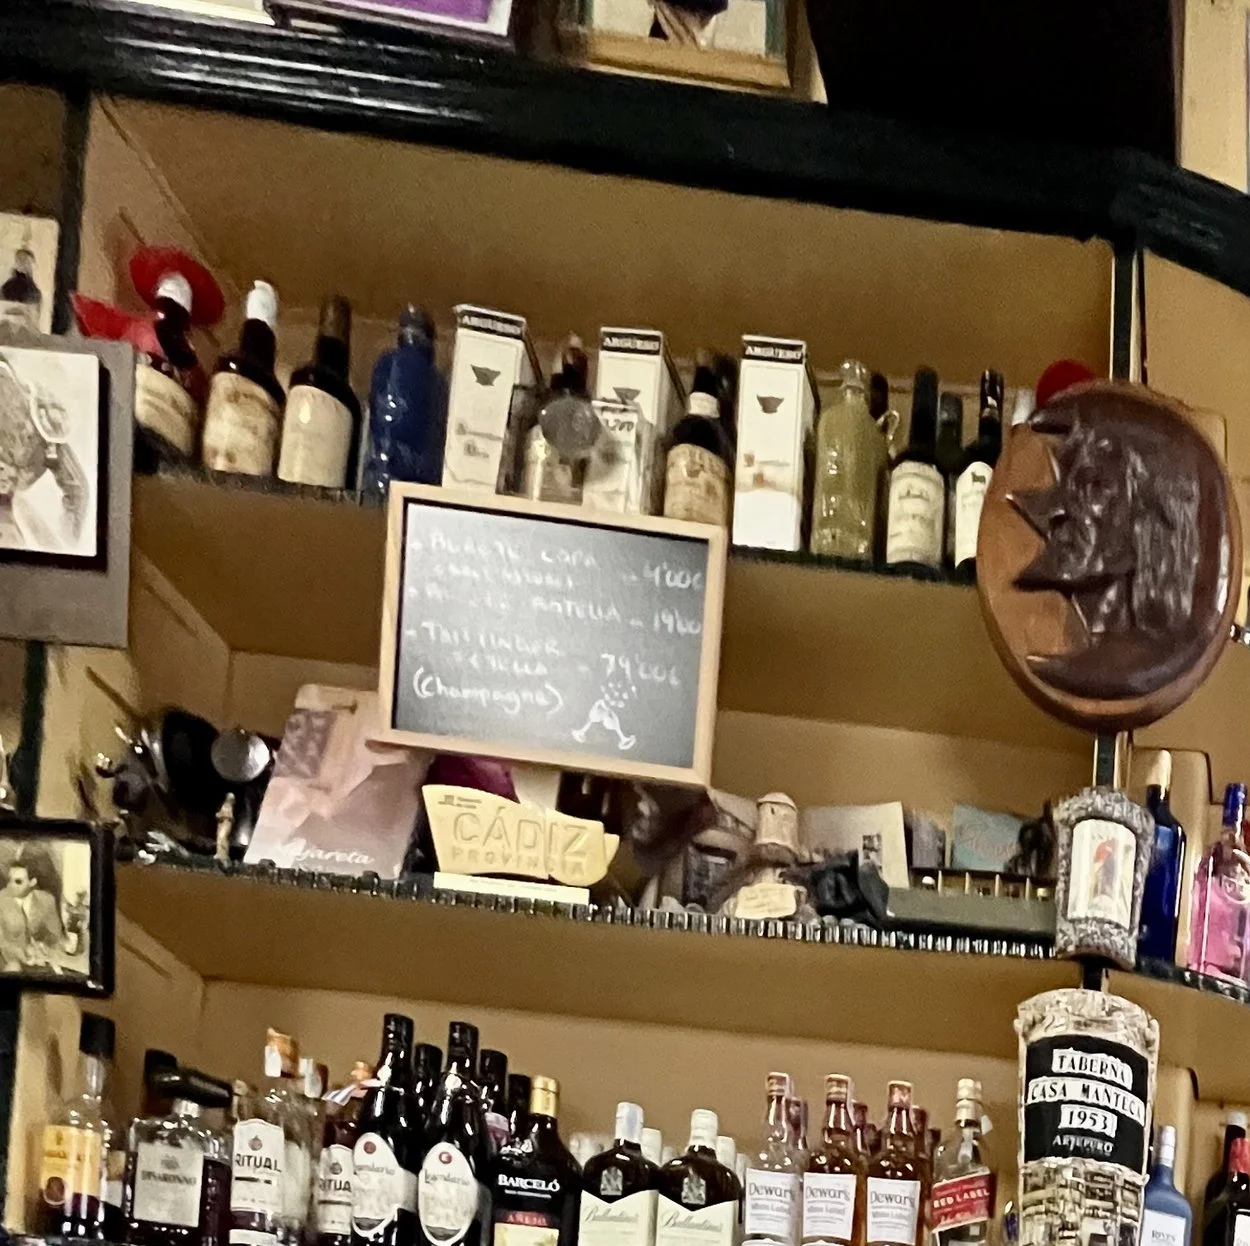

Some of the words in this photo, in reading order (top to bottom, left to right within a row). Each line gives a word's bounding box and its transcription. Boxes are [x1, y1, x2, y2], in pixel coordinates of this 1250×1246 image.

[452, 807, 588, 858] CÁDIZ
[1058, 1055, 1126, 1083] TABERNA
[1032, 1081, 1068, 1101] CASA
[1081, 1083, 1141, 1118] MANTECA
[1068, 1110, 1108, 1130] 1953
[235, 1153, 282, 1174] RITUAL
[318, 1178, 352, 1193] RITUA
[497, 1173, 561, 1193] BARCELÓ
[933, 1196, 954, 1208] RED
[956, 1188, 990, 1203] LABEL
